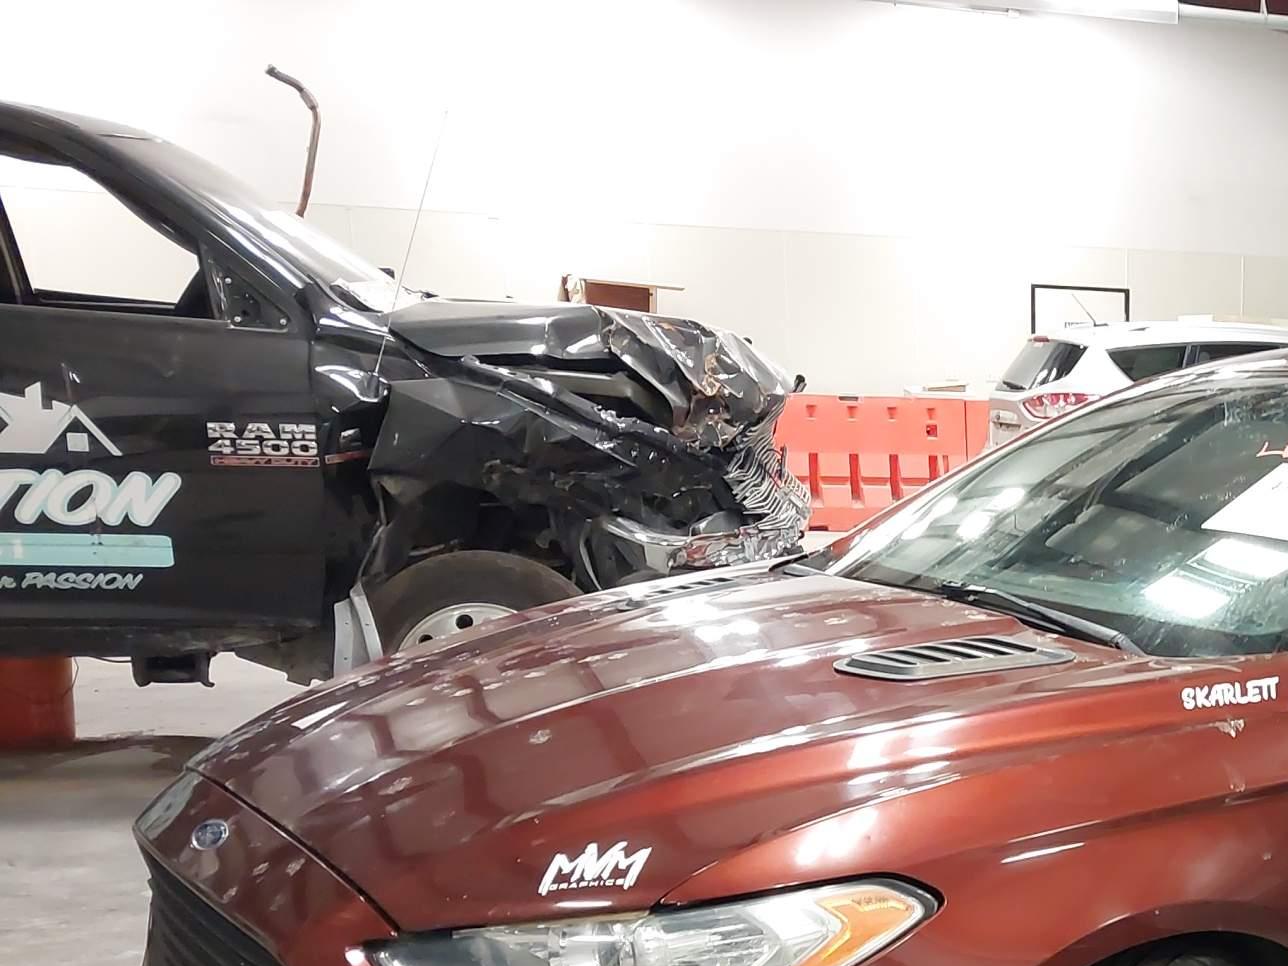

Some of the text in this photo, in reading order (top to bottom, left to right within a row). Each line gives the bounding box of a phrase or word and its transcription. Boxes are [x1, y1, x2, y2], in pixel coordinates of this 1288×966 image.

[206, 421, 318, 440] RAM
[207, 439, 319, 456] 4500
[21, 572, 144, 590] PASSION
[1181, 676, 1280, 710] SKARLETT
[548, 878, 625, 892] GRAPHICS
